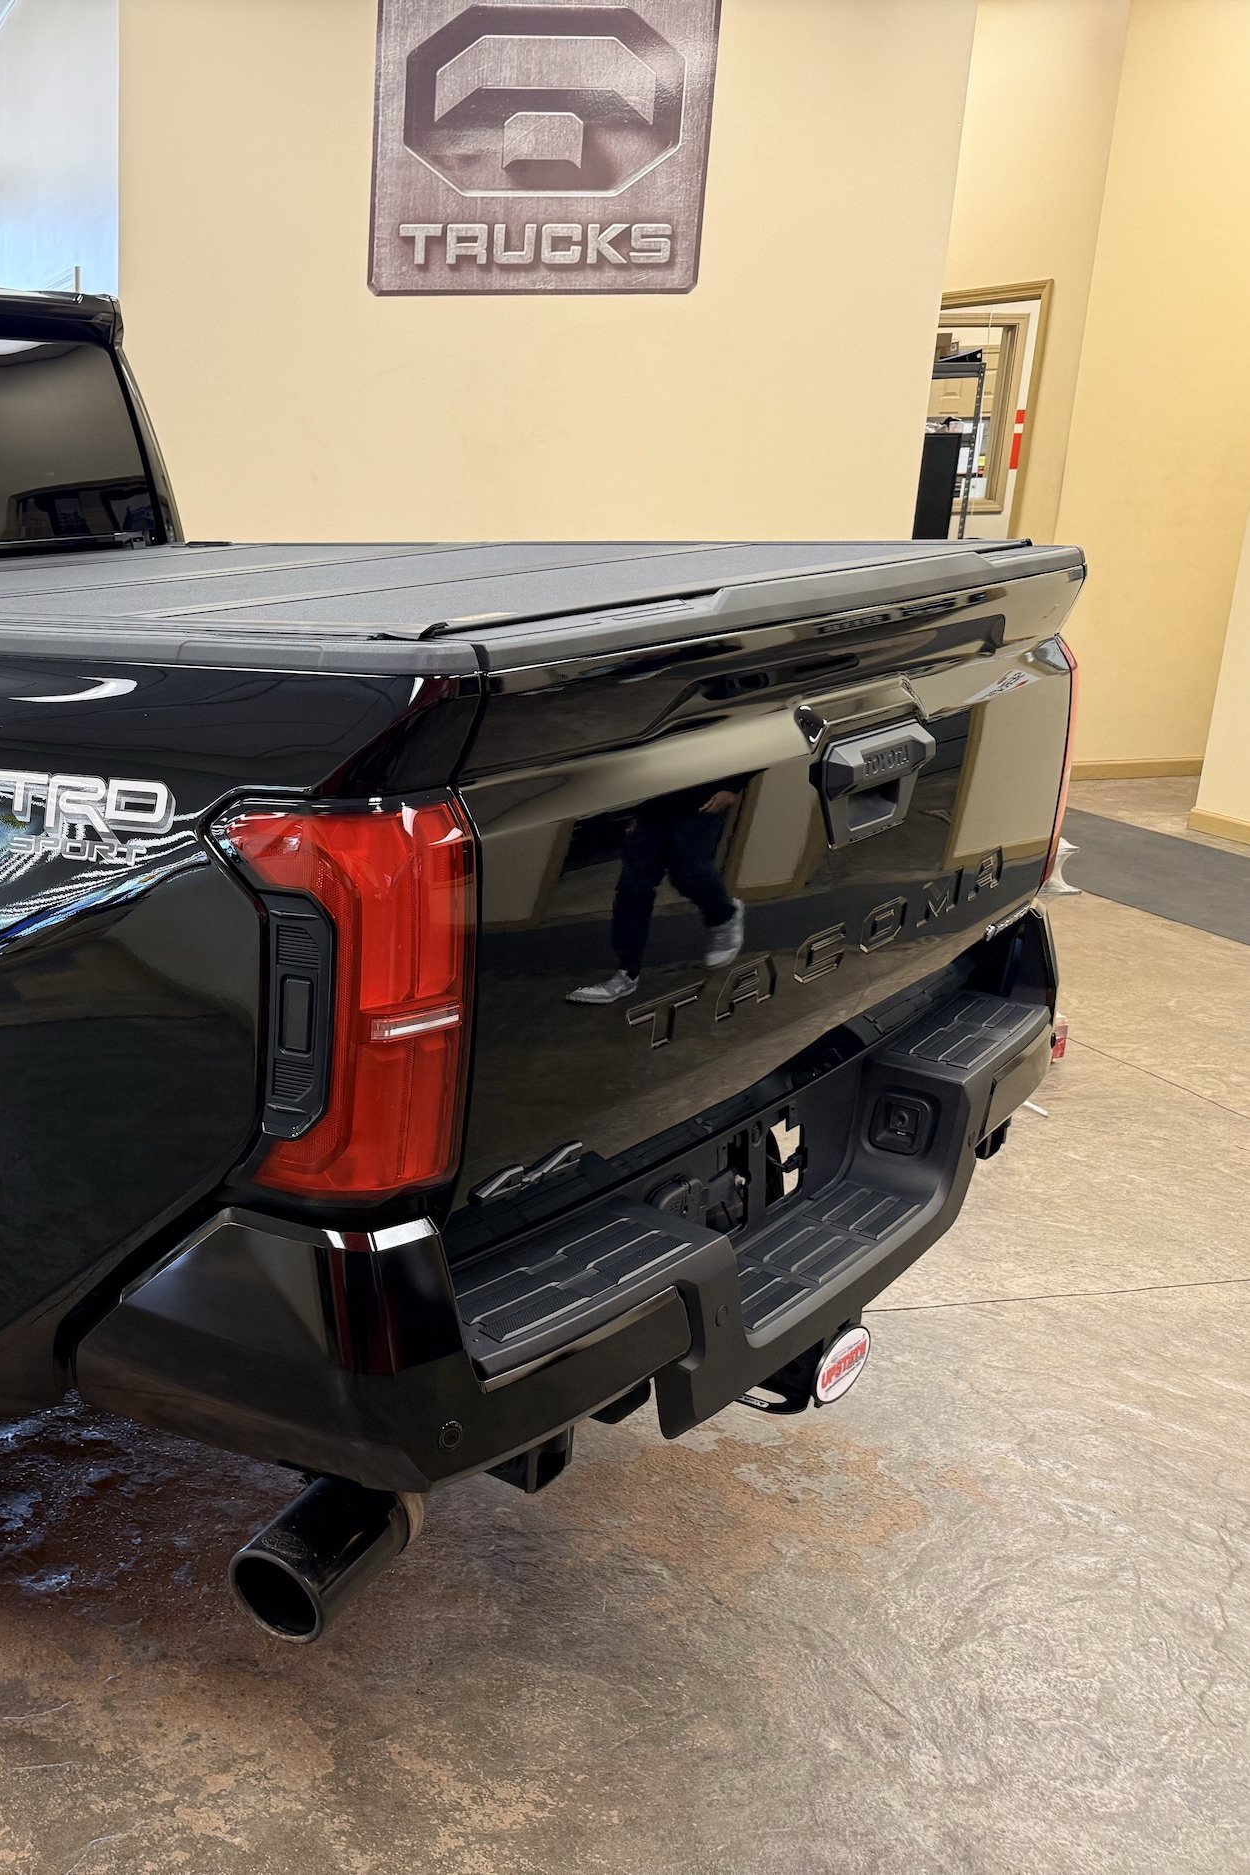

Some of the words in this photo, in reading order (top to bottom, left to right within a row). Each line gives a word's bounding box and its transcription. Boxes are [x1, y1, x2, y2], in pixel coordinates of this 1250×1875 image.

[399, 223, 673, 266] TRUCKS
[863, 744, 910, 777] TOYOTA
[8, 835, 148, 867] SPORT
[626, 845, 1003, 1048] TACOMA
